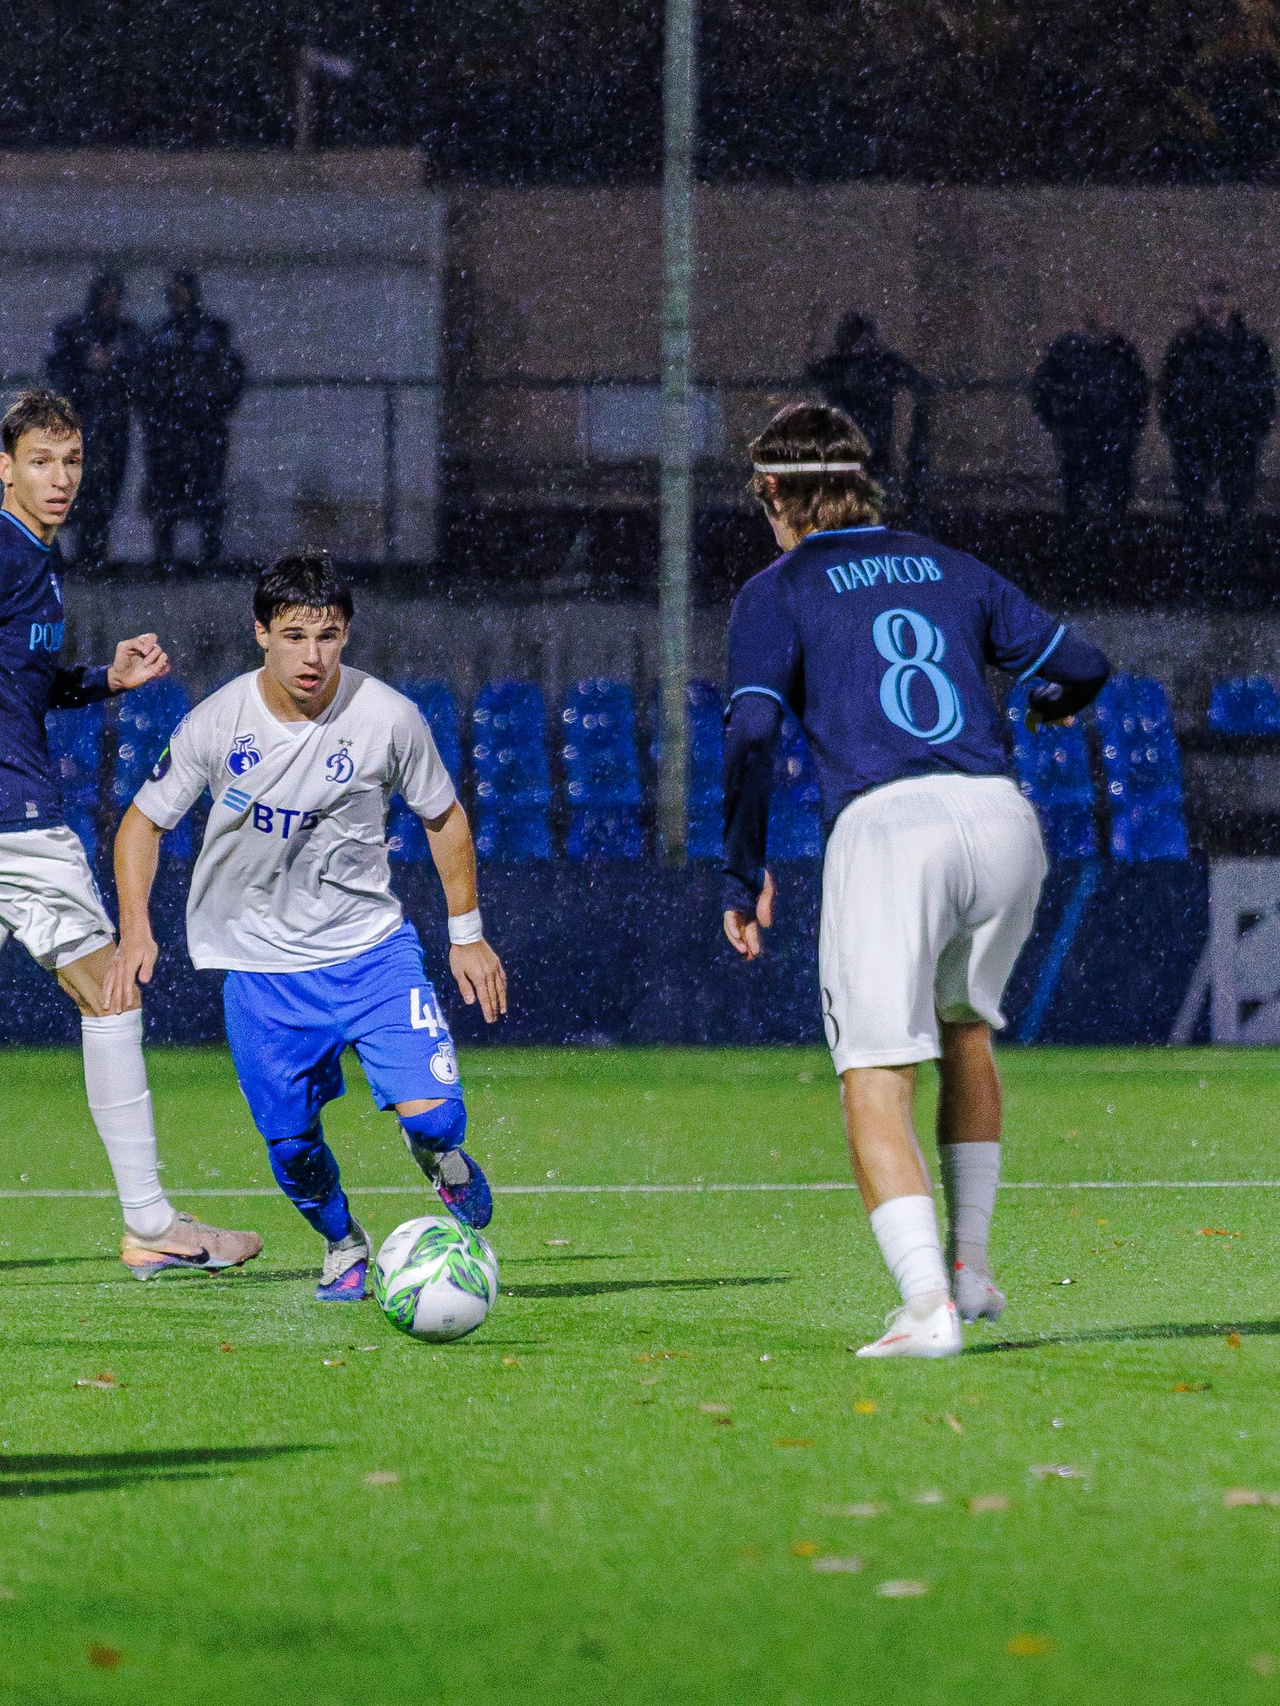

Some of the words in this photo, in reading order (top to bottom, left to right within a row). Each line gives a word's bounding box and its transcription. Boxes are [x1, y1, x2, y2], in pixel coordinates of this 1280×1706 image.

[826, 555, 944, 594] ПАРУСОВ
[872, 607, 966, 746] 8
[252, 801, 324, 840] ВТБ
